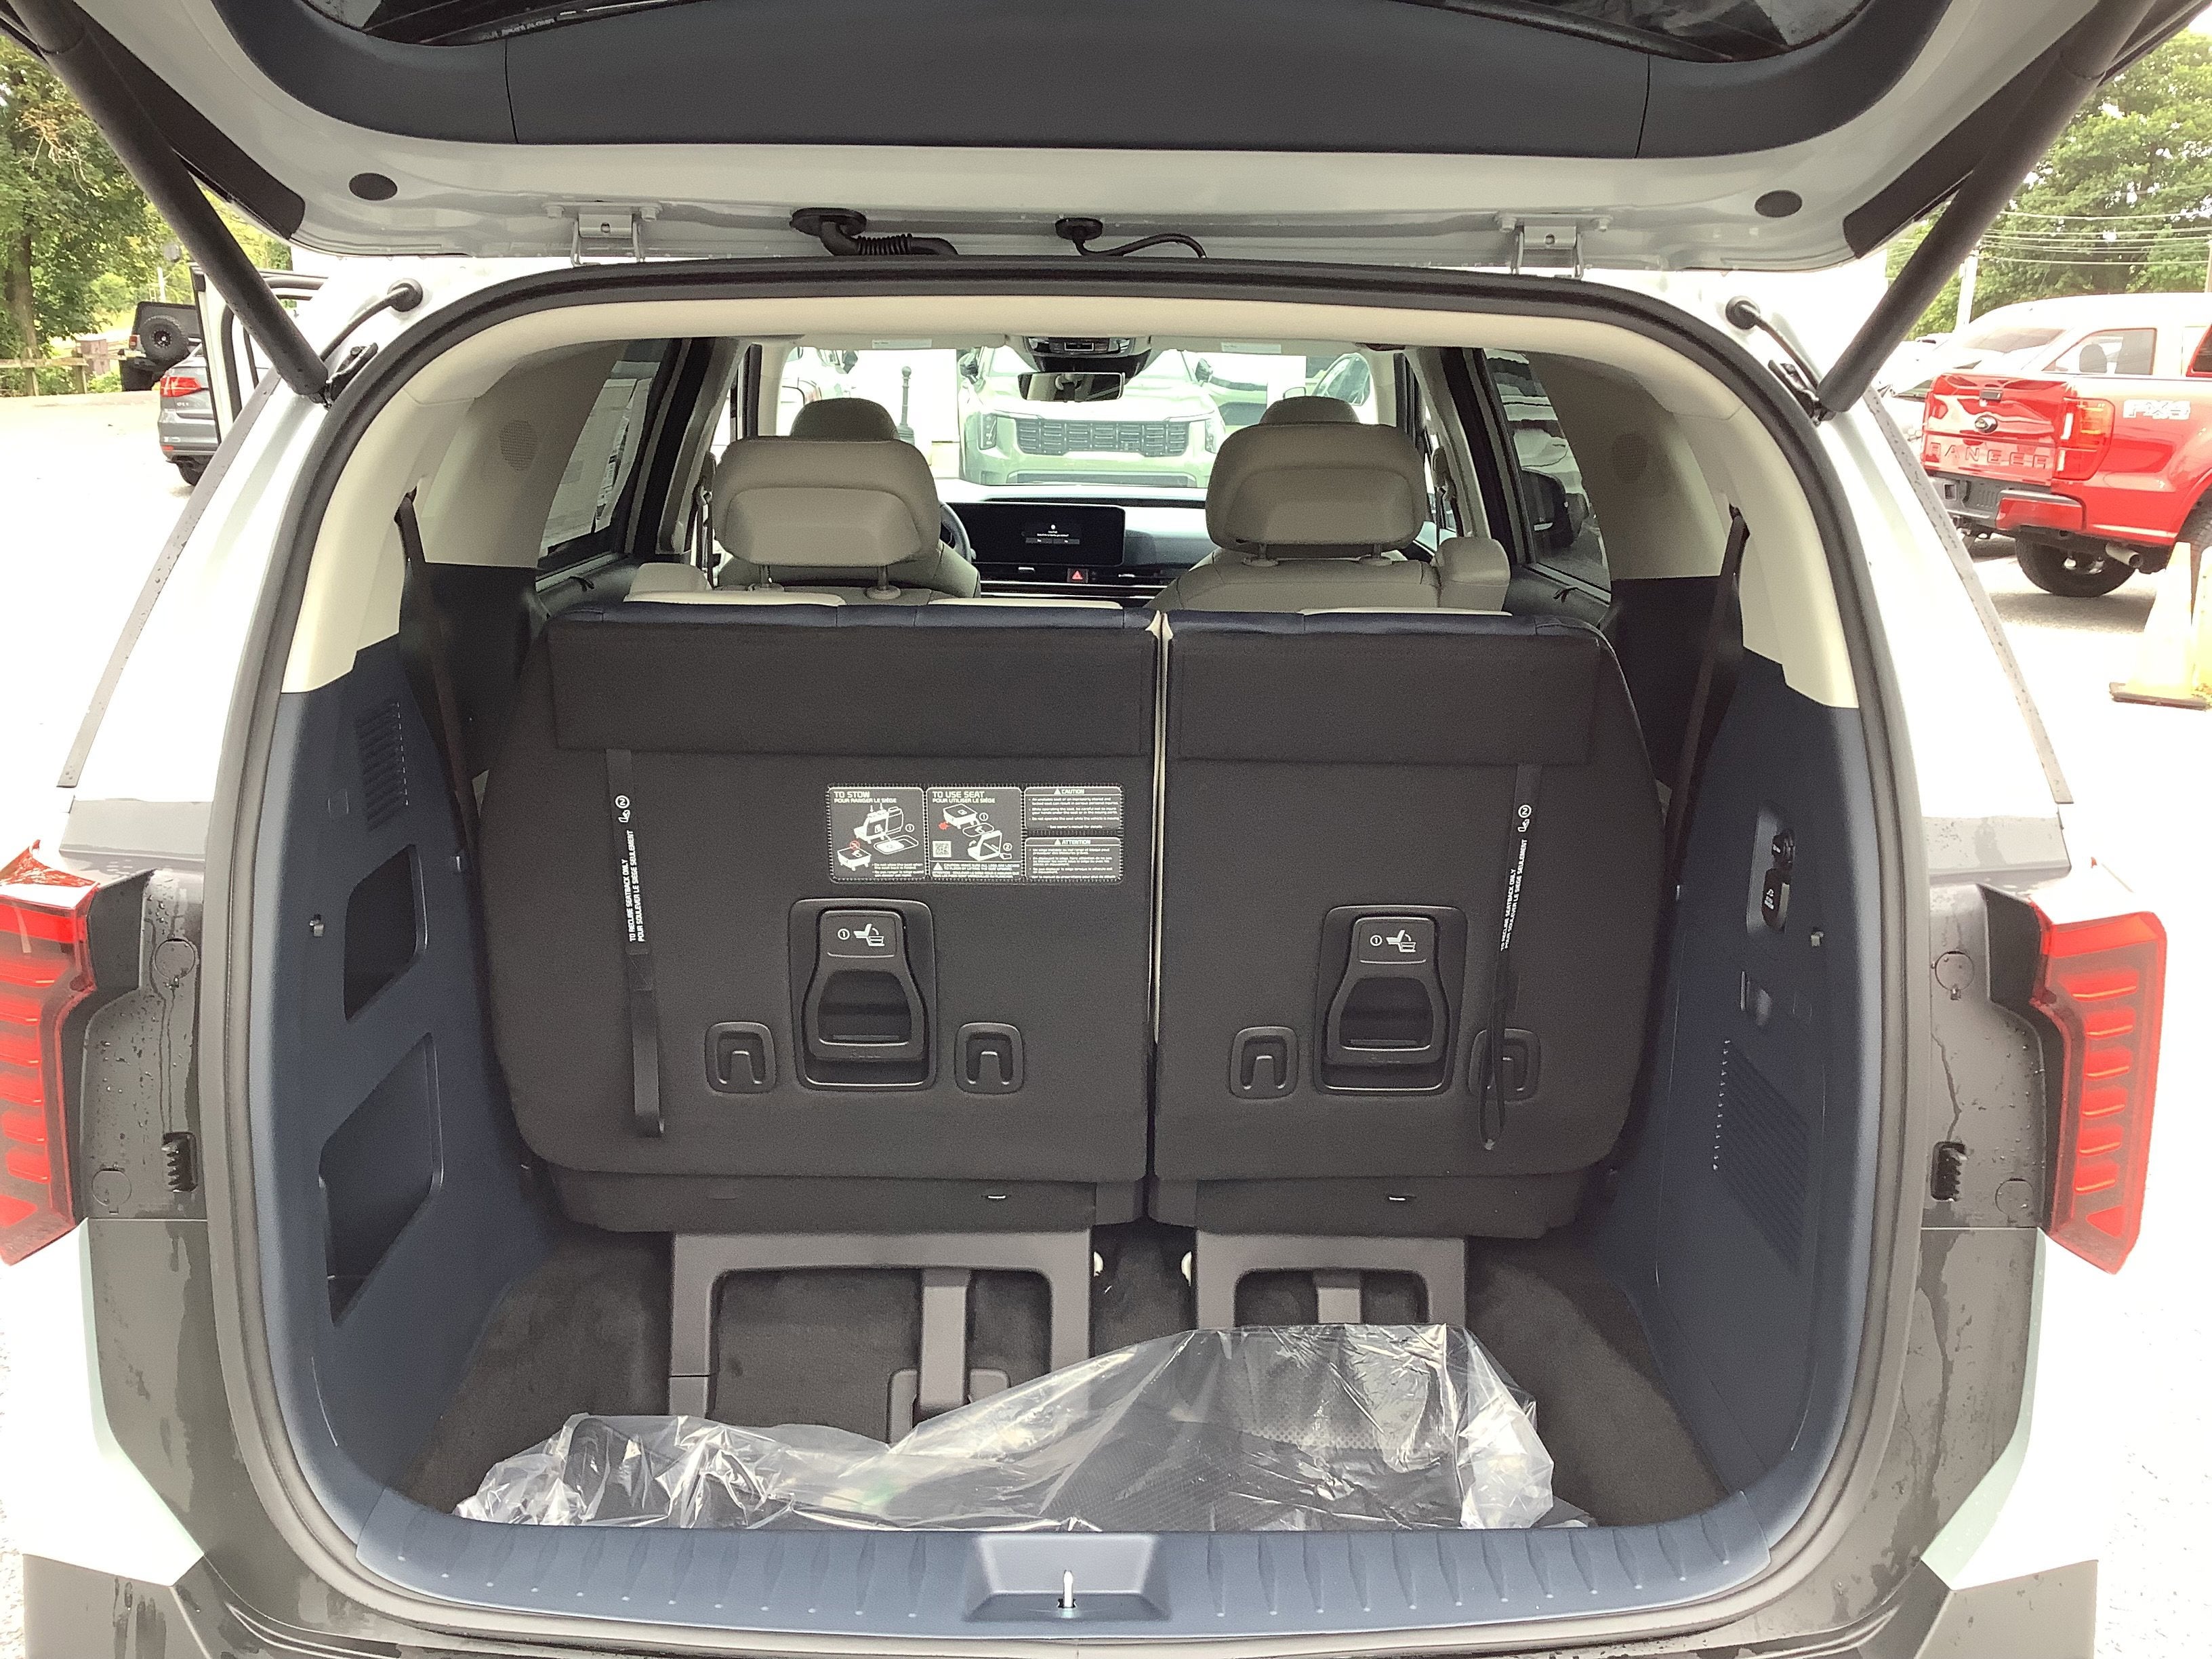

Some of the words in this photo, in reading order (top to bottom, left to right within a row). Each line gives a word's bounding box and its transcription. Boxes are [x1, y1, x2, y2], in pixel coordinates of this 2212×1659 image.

[1931, 442, 2050, 469] RANGER
[626, 830, 637, 866] SEULEMENT
[621, 859, 630, 875] ONLY
[623, 876, 633, 907] SEATBACK
[632, 885, 640, 893] LE
[626, 908, 635, 933] RECLINE
[633, 894, 643, 924] SOULEVER
[629, 933, 636, 941] TO
